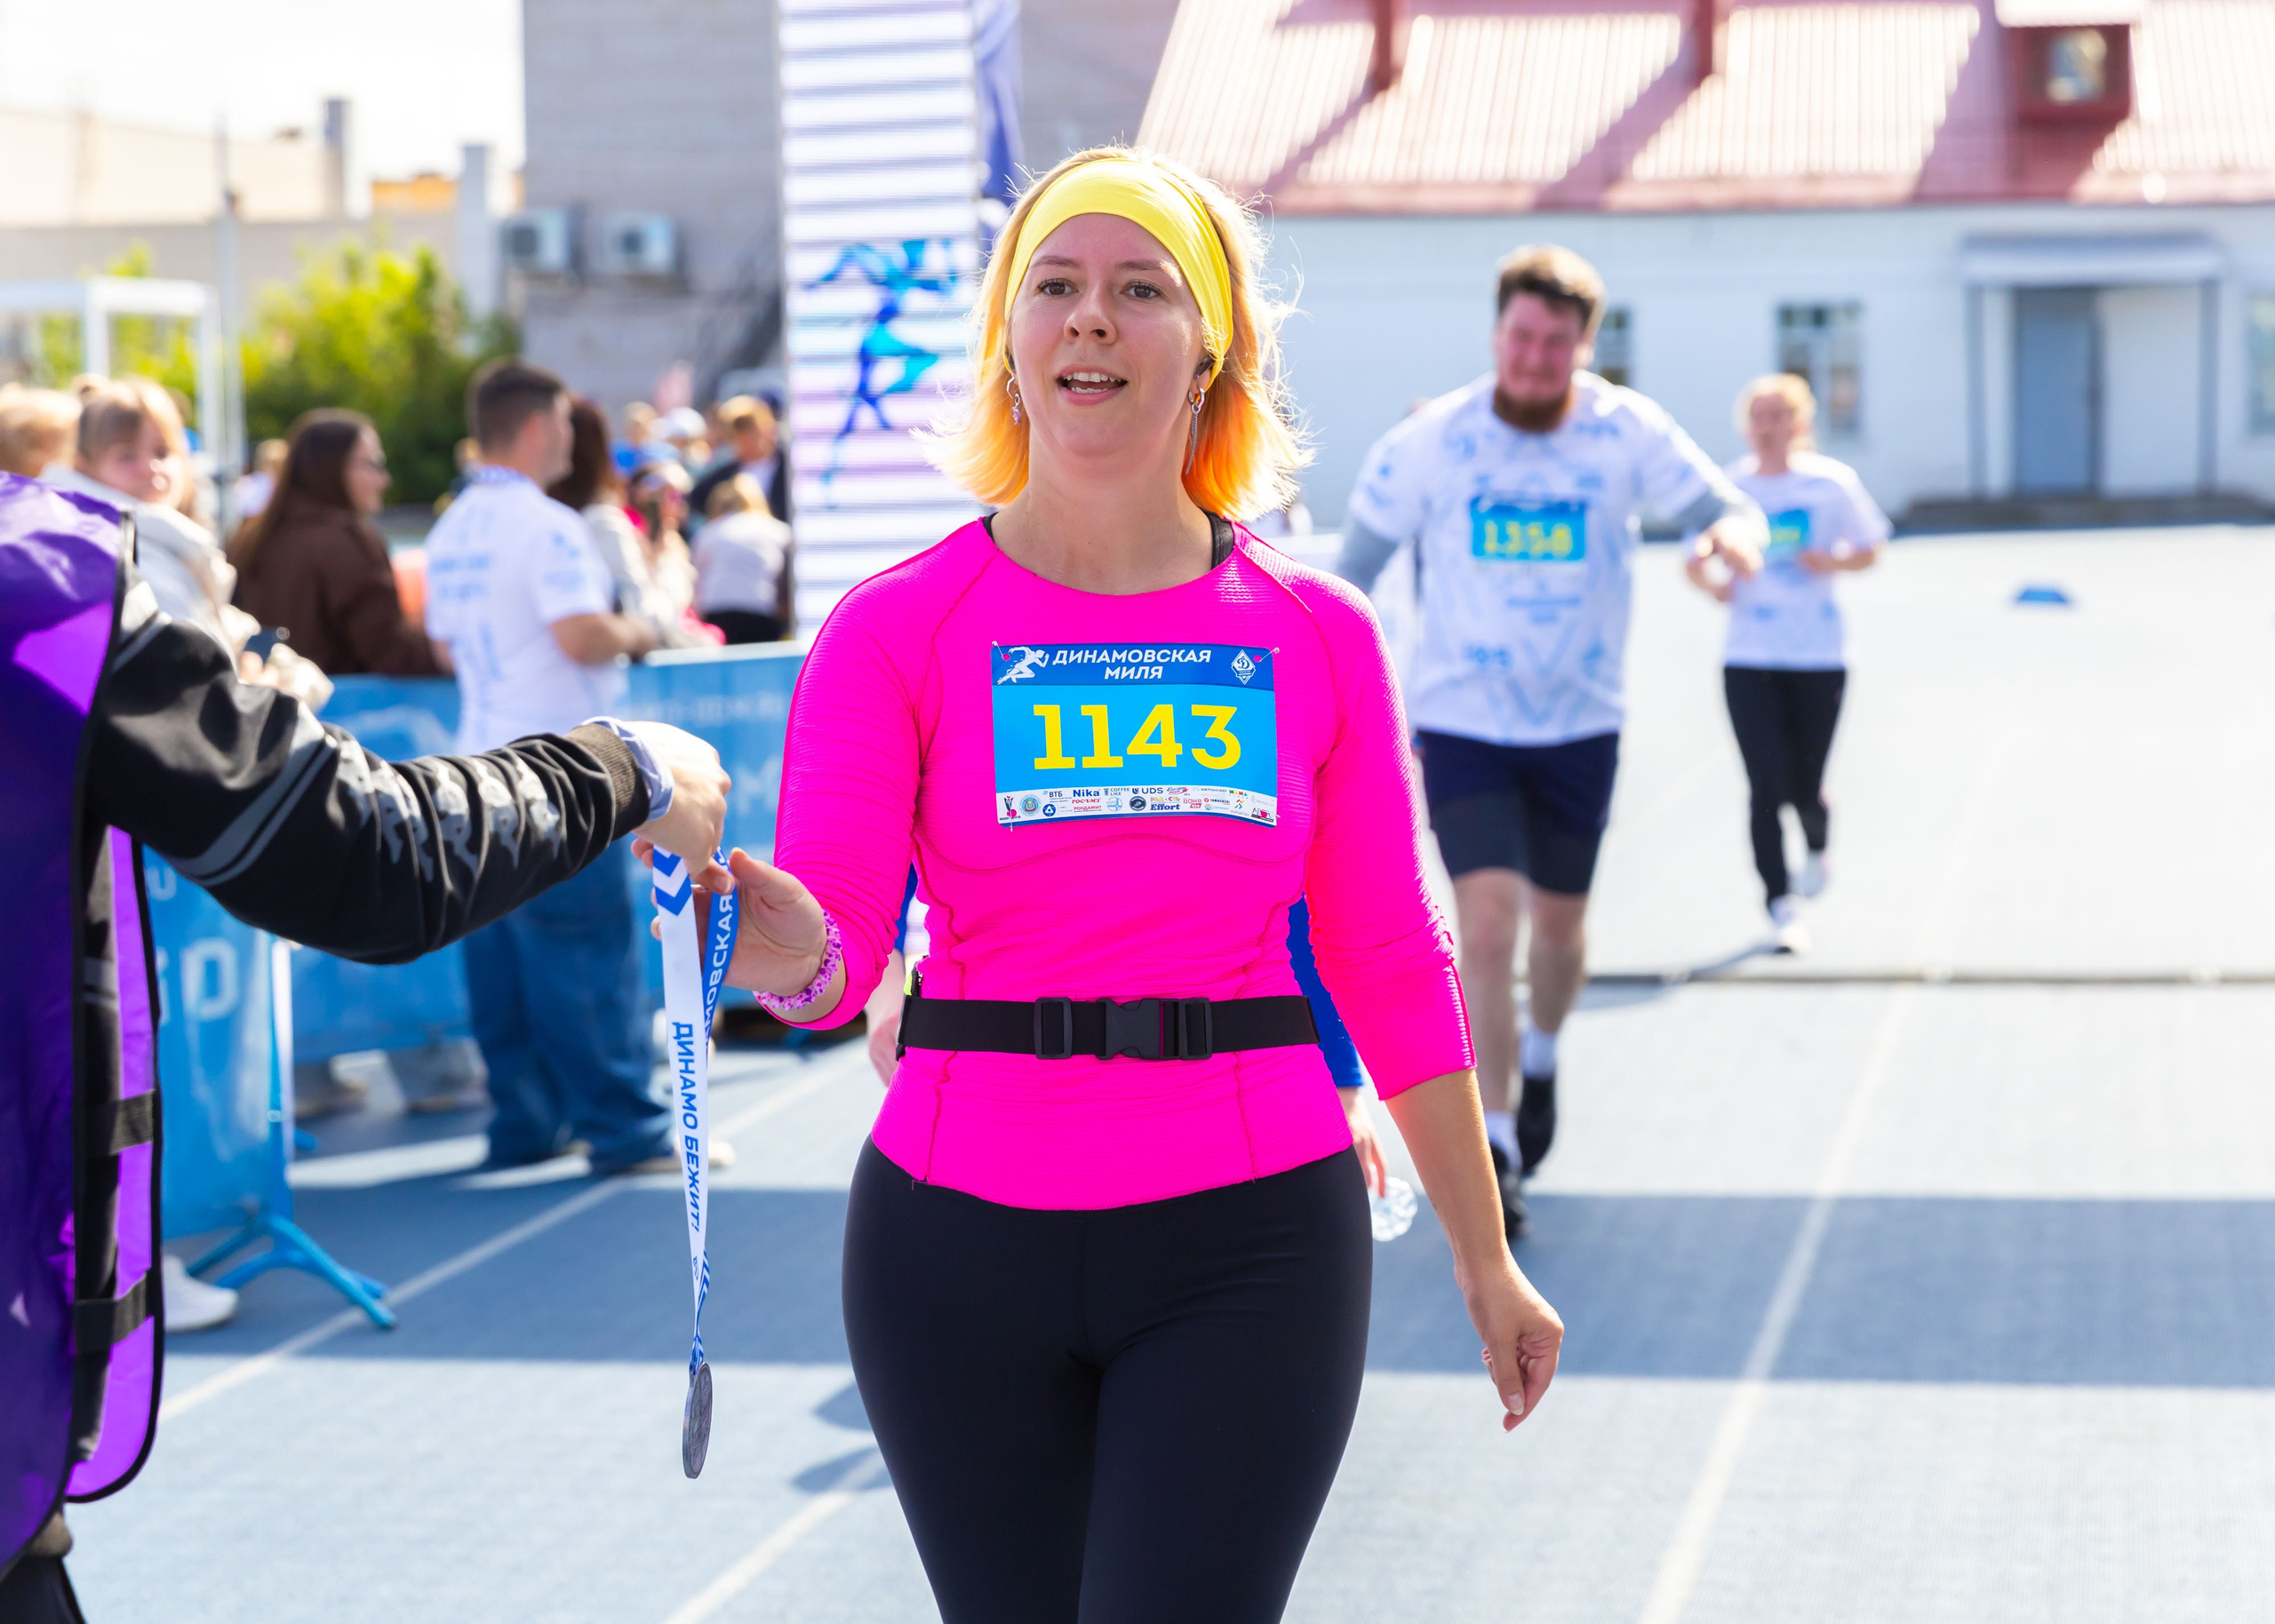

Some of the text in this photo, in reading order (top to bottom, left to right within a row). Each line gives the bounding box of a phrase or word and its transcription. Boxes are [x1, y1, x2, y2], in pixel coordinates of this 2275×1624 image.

[1052, 649, 1212, 666] ДИНАМОВСКАЯ
[1104, 665, 1163, 680] МИЛЯ
[1033, 704, 1241, 769] 1143
[671, 1022, 700, 1232] ДИНАМО БЕЖИТ!
